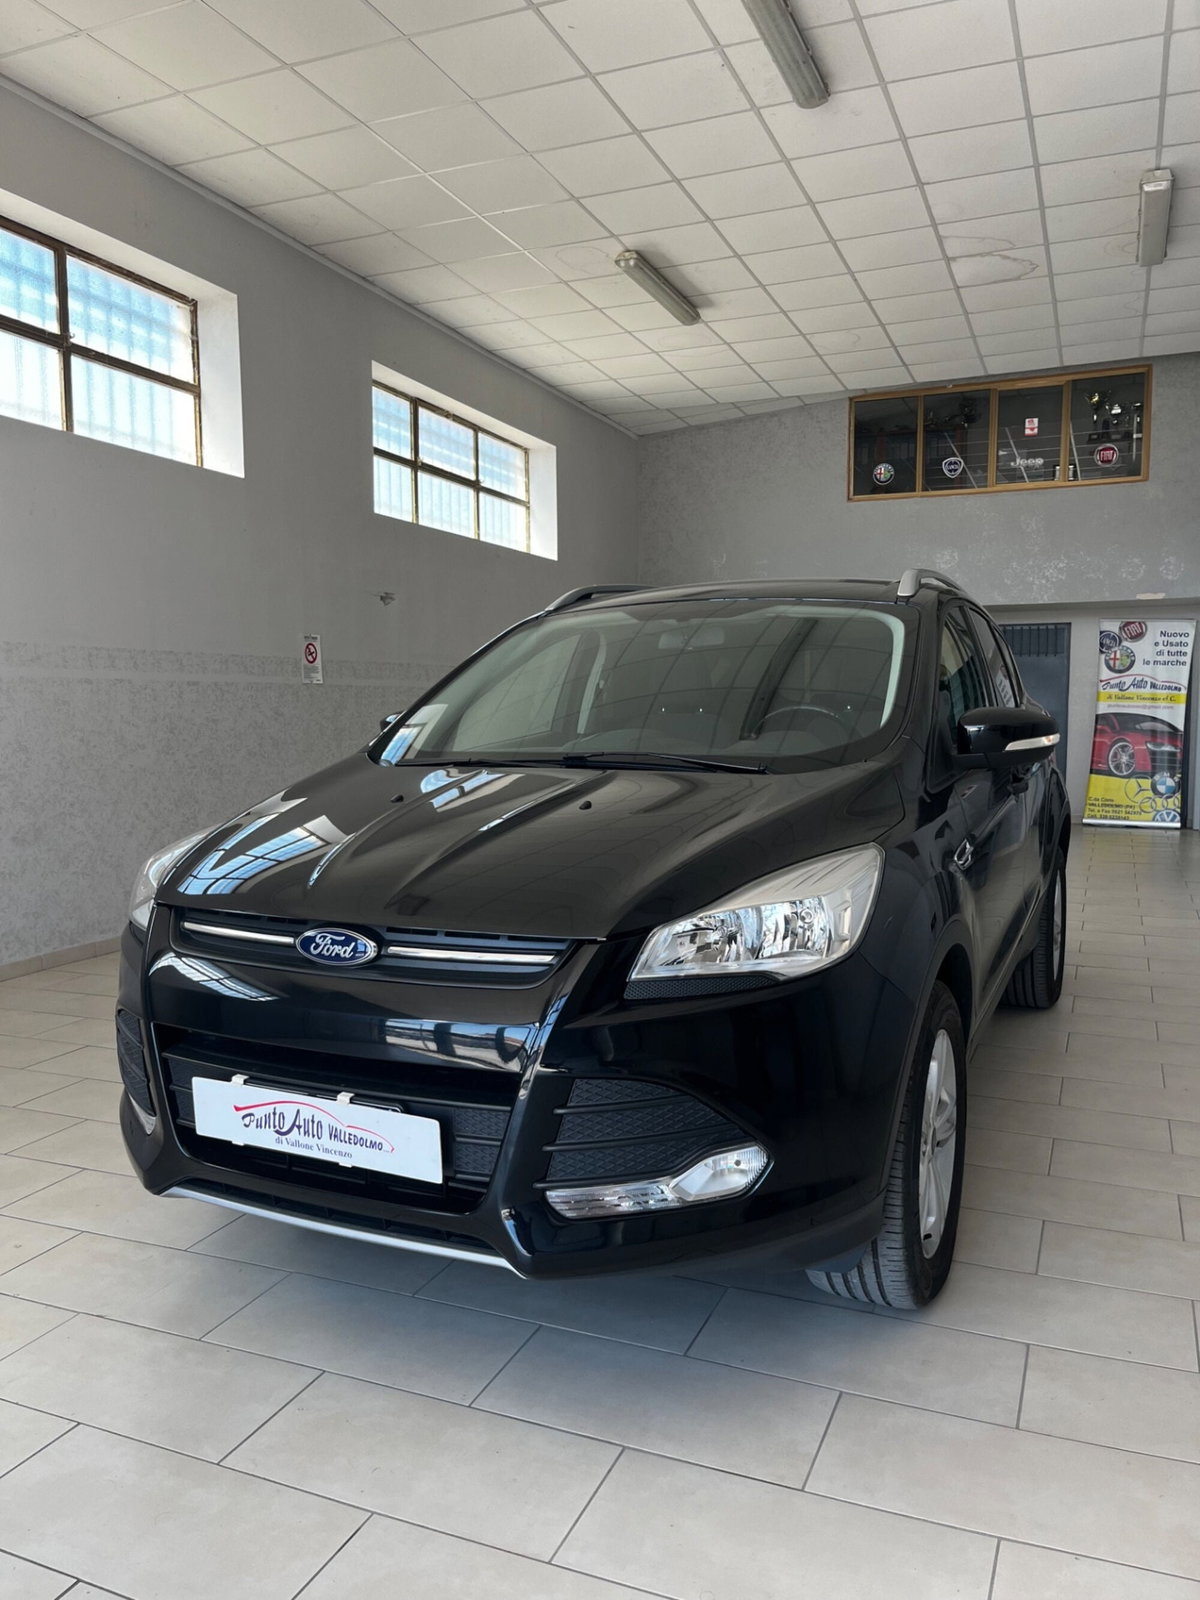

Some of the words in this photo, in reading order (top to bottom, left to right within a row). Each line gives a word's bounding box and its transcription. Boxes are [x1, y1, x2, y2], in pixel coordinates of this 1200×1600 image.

[1010, 456, 1044, 469] Jeep
[1100, 450, 1114, 462] FIAT
[1124, 622, 1142, 638] FIAT
[1160, 630, 1190, 639] Nuovo
[1162, 640, 1189, 648] Usato
[1156, 649, 1164, 657] di
[1167, 649, 1188, 657] tutte
[1153, 659, 1187, 667] marche
[1102, 680, 1126, 691] Punto
[1119, 677, 1148, 692] Auto
[1150, 681, 1182, 692] VALLEDOLMO
[310, 933, 356, 958] Ford
[242, 1107, 286, 1128] Punto
[273, 1109, 323, 1141] Auto
[275, 1136, 284, 1146] di
[284, 1137, 314, 1151] Vallone
[316, 1143, 353, 1159] Vincenzo
